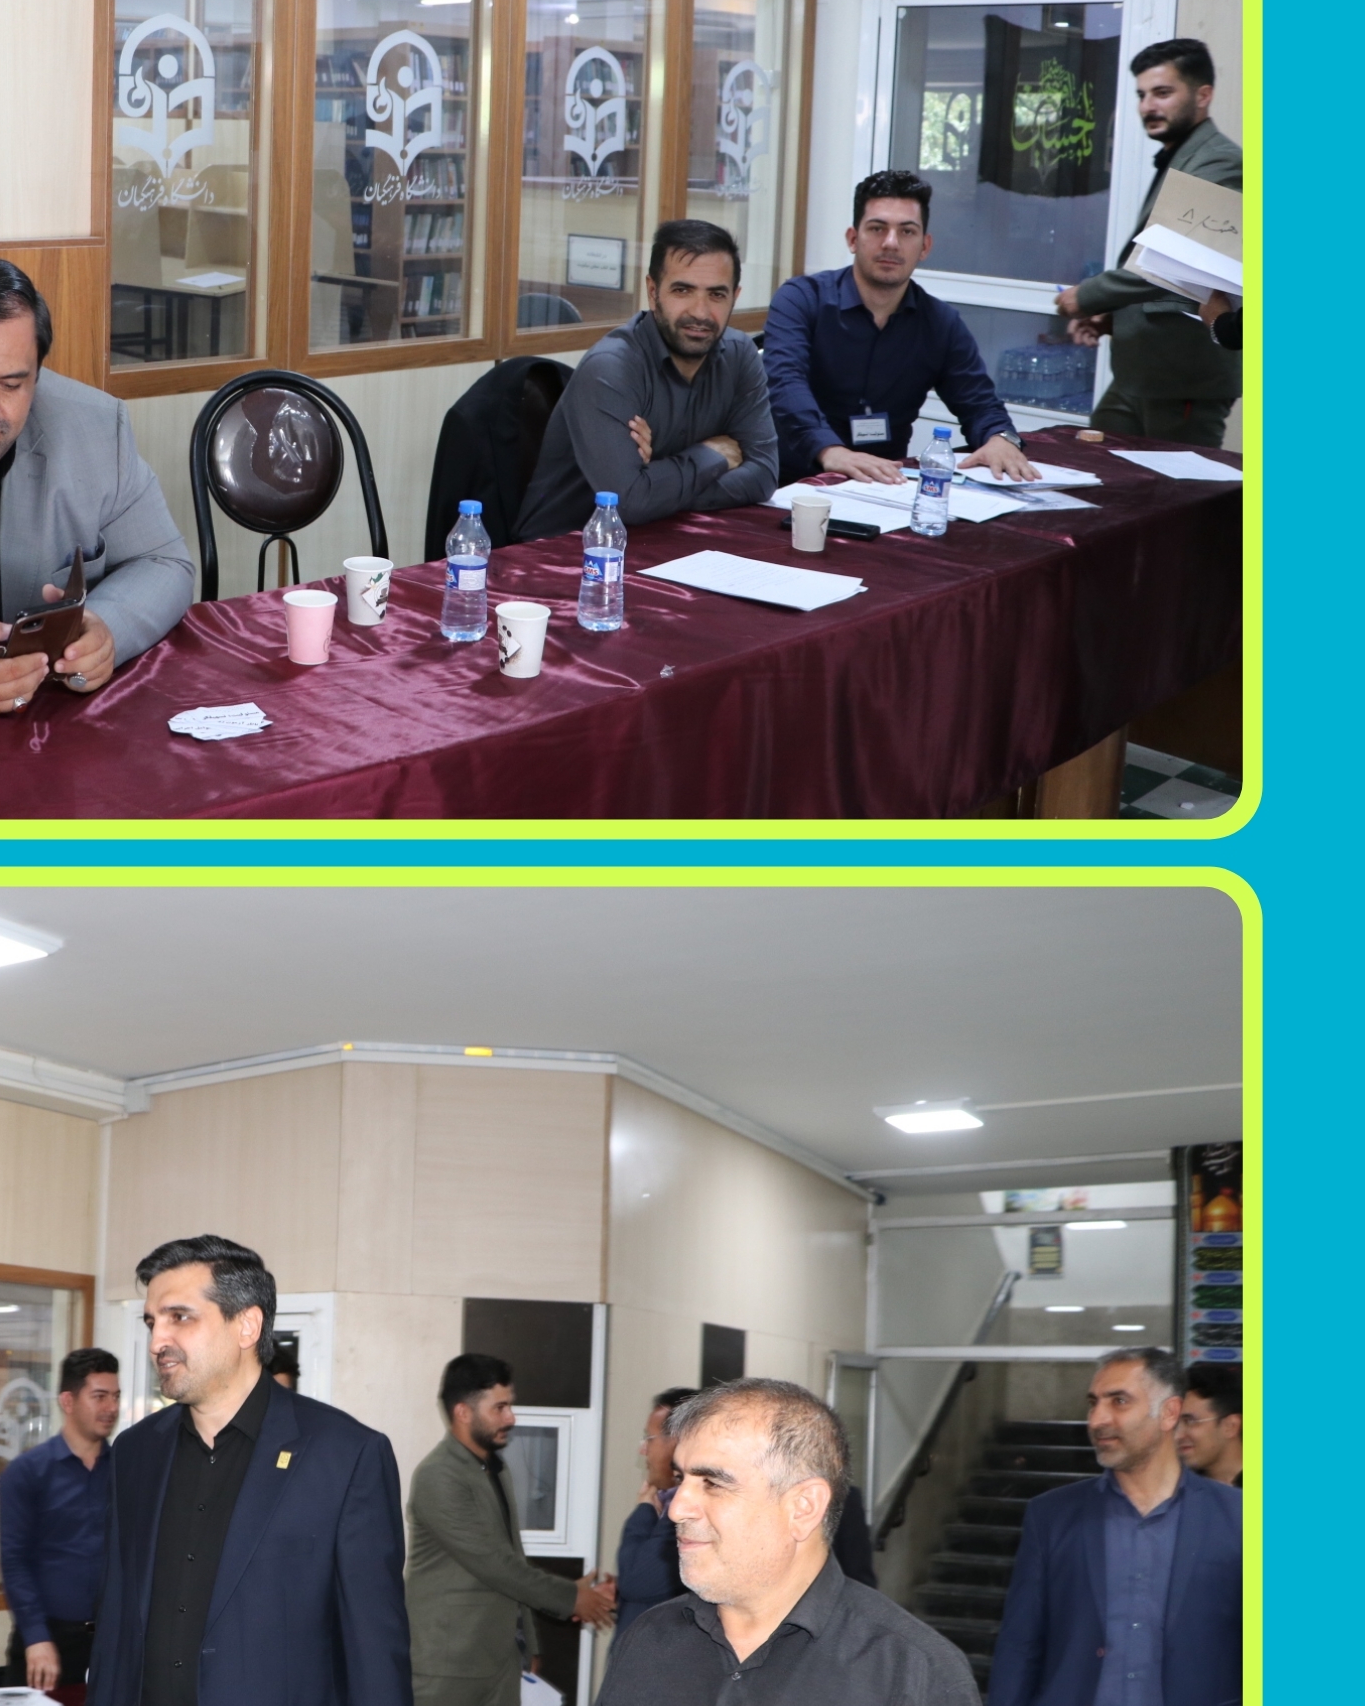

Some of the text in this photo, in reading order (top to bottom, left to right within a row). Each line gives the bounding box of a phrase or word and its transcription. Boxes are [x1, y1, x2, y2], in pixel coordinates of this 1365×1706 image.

[117, 175, 215, 212] دانشگاه فرهنگیان
[364, 173, 442, 207] دانشگاه فرهنگیان
